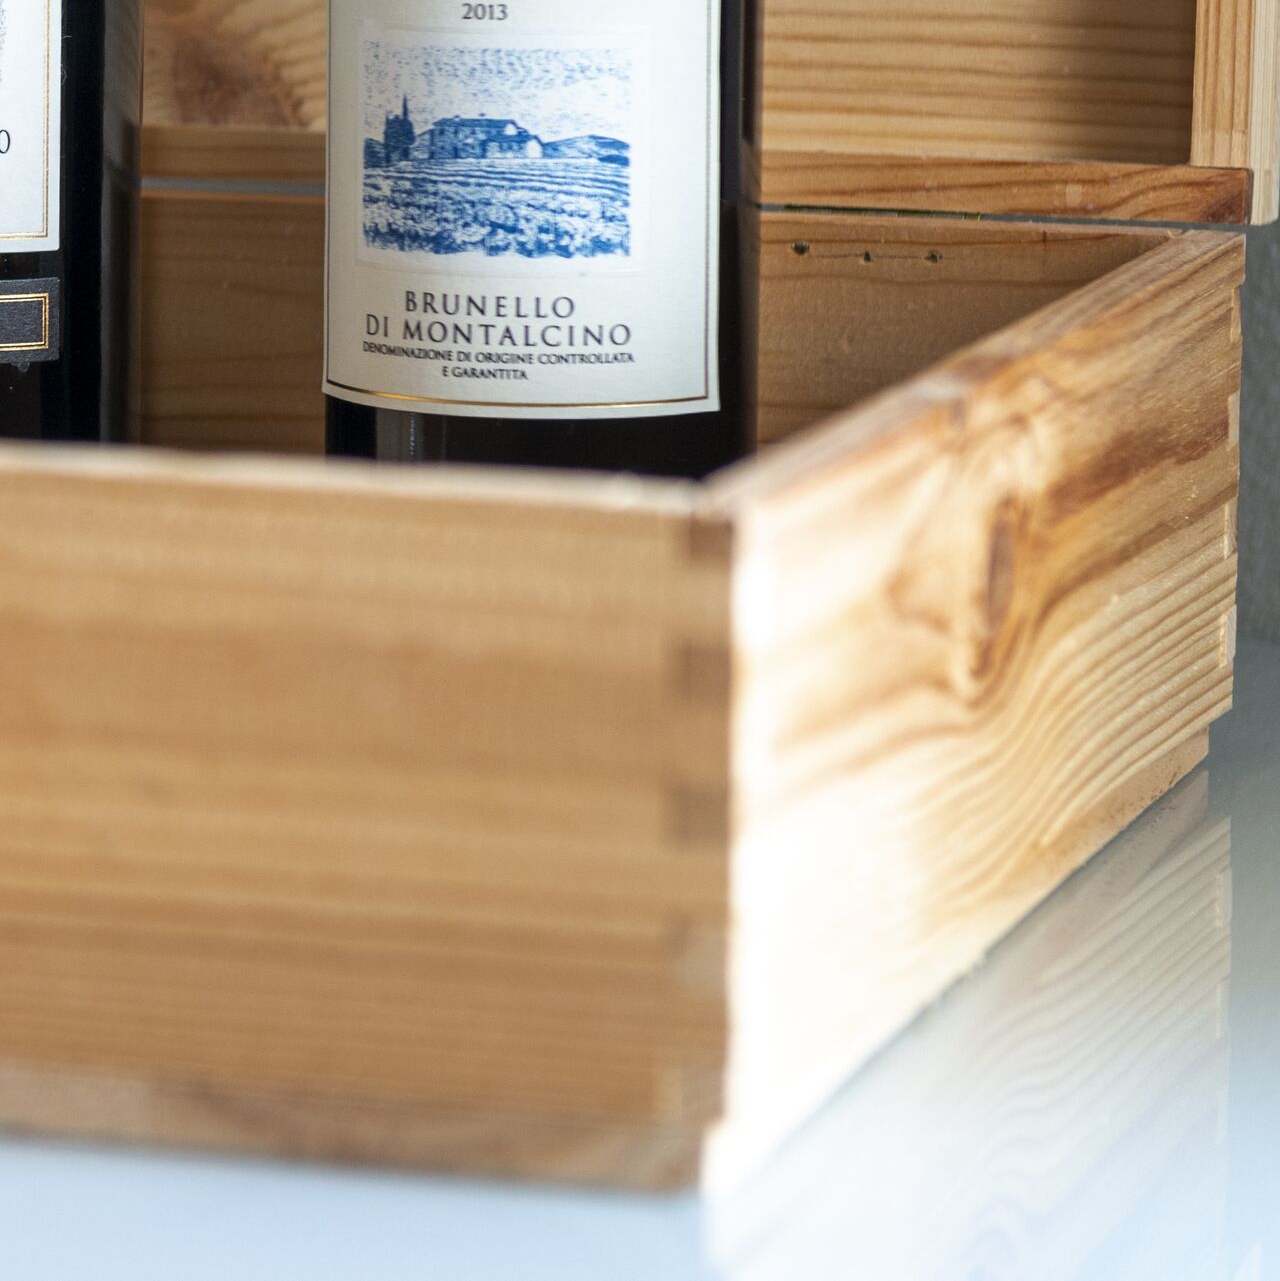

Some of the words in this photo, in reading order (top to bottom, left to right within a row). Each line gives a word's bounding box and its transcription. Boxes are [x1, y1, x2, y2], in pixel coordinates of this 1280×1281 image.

[462, 3, 508, 21] 2013
[405, 290, 576, 319] BRUNELLO
[366, 313, 389, 337] DI
[402, 319, 632, 347] MONTALCINO
[363, 341, 453, 362] DENOMINAZIONE
[456, 350, 472, 362] DI
[475, 351, 534, 364] ORIGINE
[538, 352, 636, 365] CONTROLLATA
[443, 365, 449, 377] E
[452, 366, 529, 381] GARANTITA
